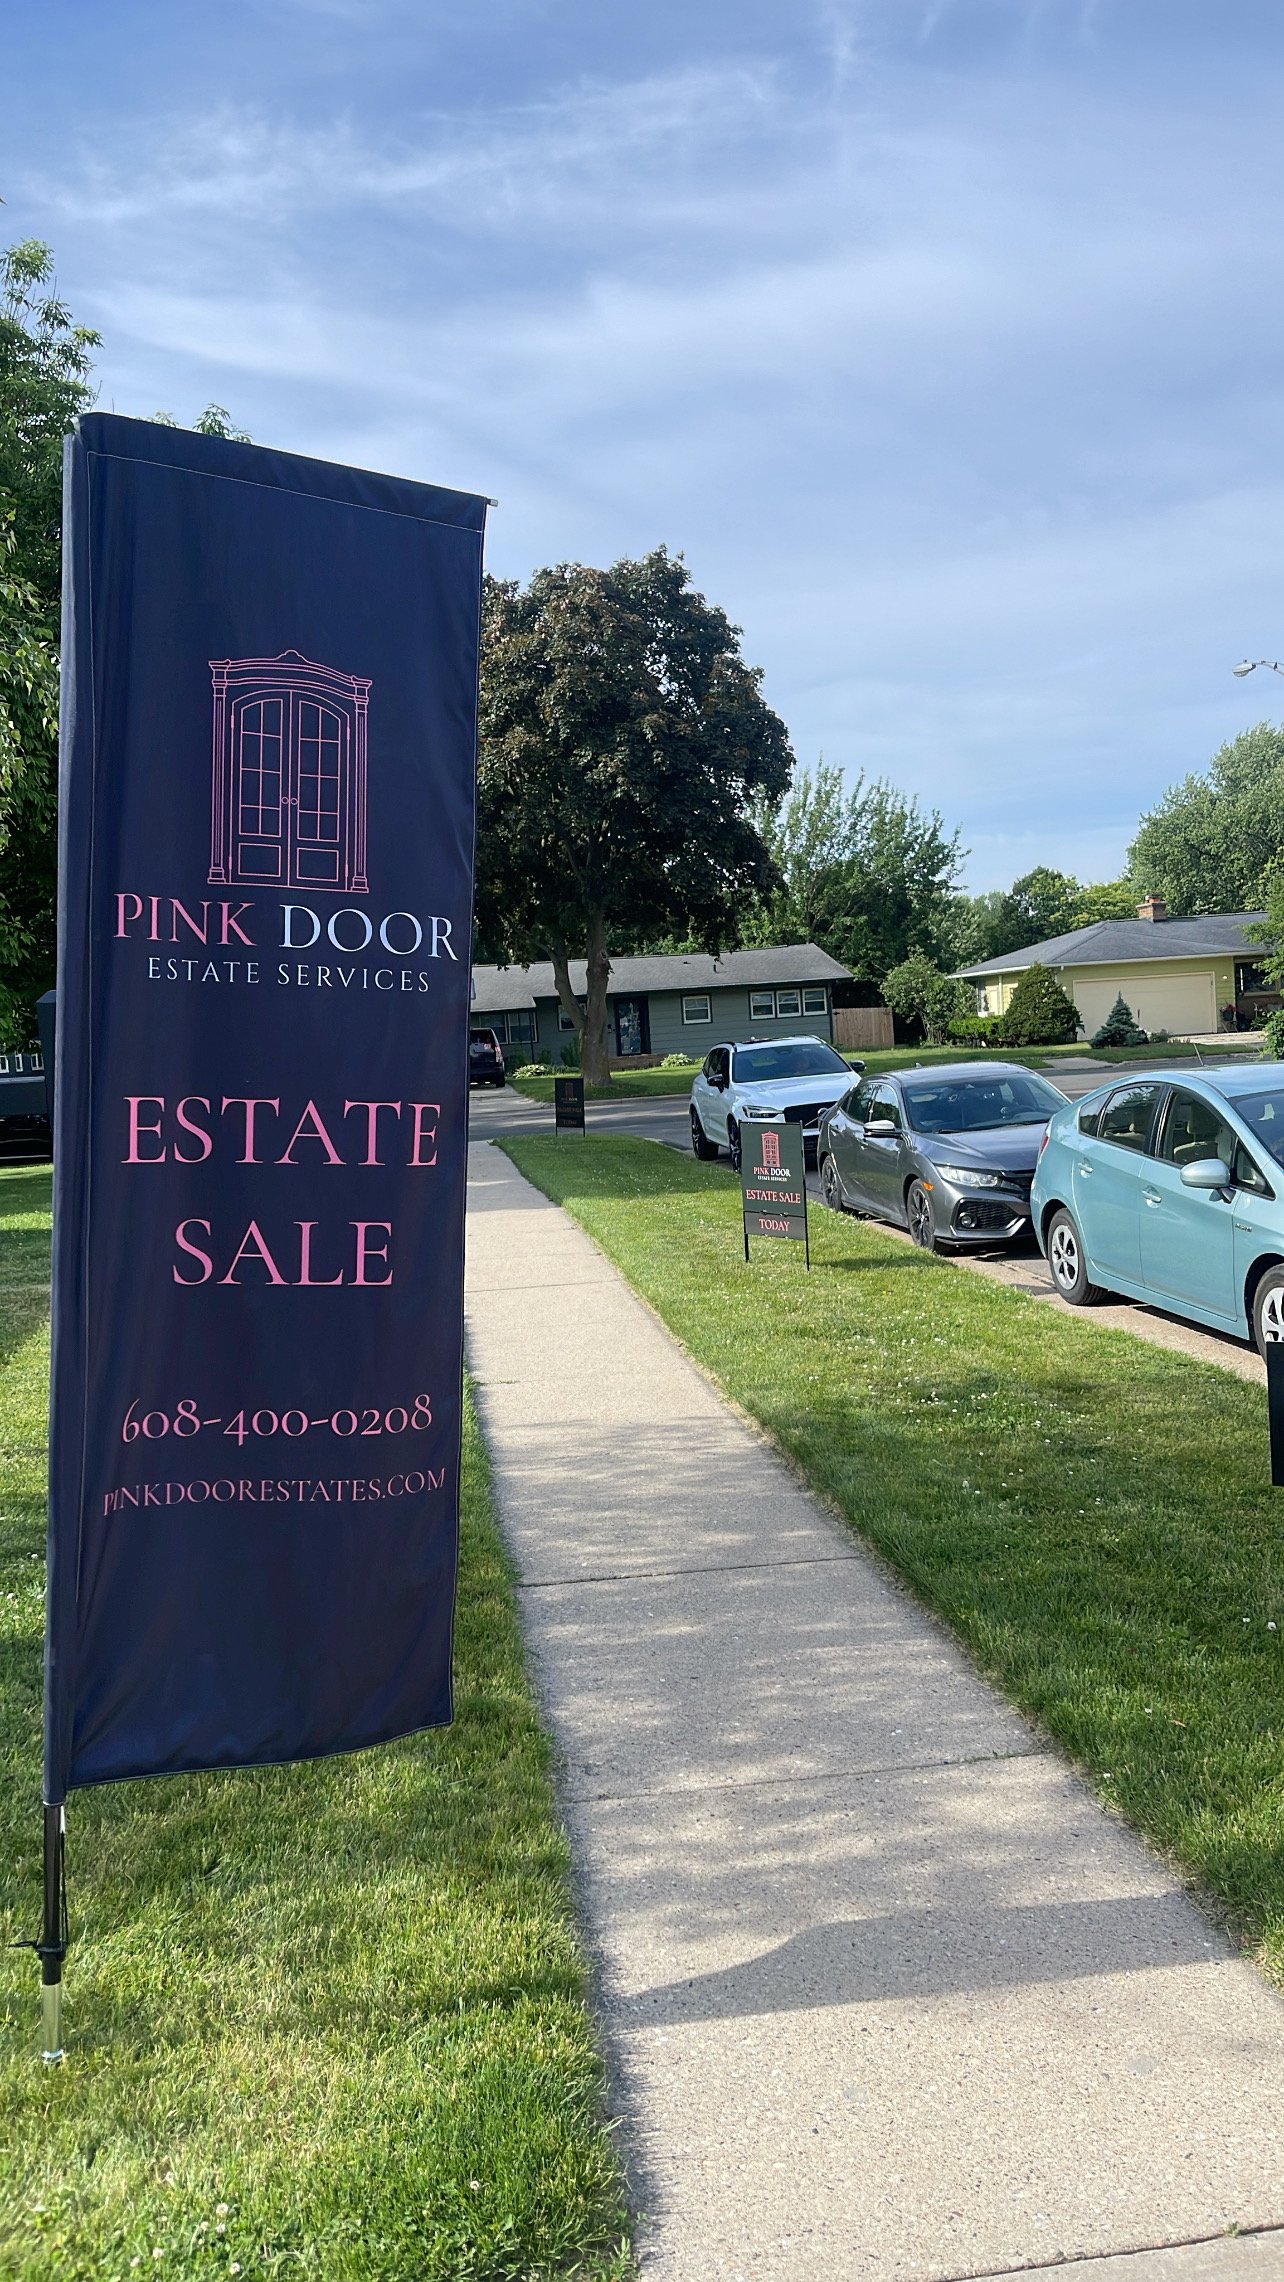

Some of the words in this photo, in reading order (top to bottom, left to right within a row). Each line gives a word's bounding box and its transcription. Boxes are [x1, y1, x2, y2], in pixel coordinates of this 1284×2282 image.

[113, 893, 257, 947] PINK
[278, 904, 458, 961] DOOR
[148, 957, 260, 984] ESTATE
[277, 963, 430, 993] SERVICES
[121, 1095, 441, 1168] ESTATE
[746, 1189, 777, 1201] ESTATE
[779, 1191, 800, 1203] SALE
[753, 1167, 769, 1175] PINK
[770, 1168, 791, 1177] DOOR
[759, 1219, 789, 1231] TODAY
[172, 1218, 394, 1287] SALE
[122, 1393, 433, 1446] 608-400-0208
[103, 1467, 447, 1517] PINKDOORESTATES.COM
